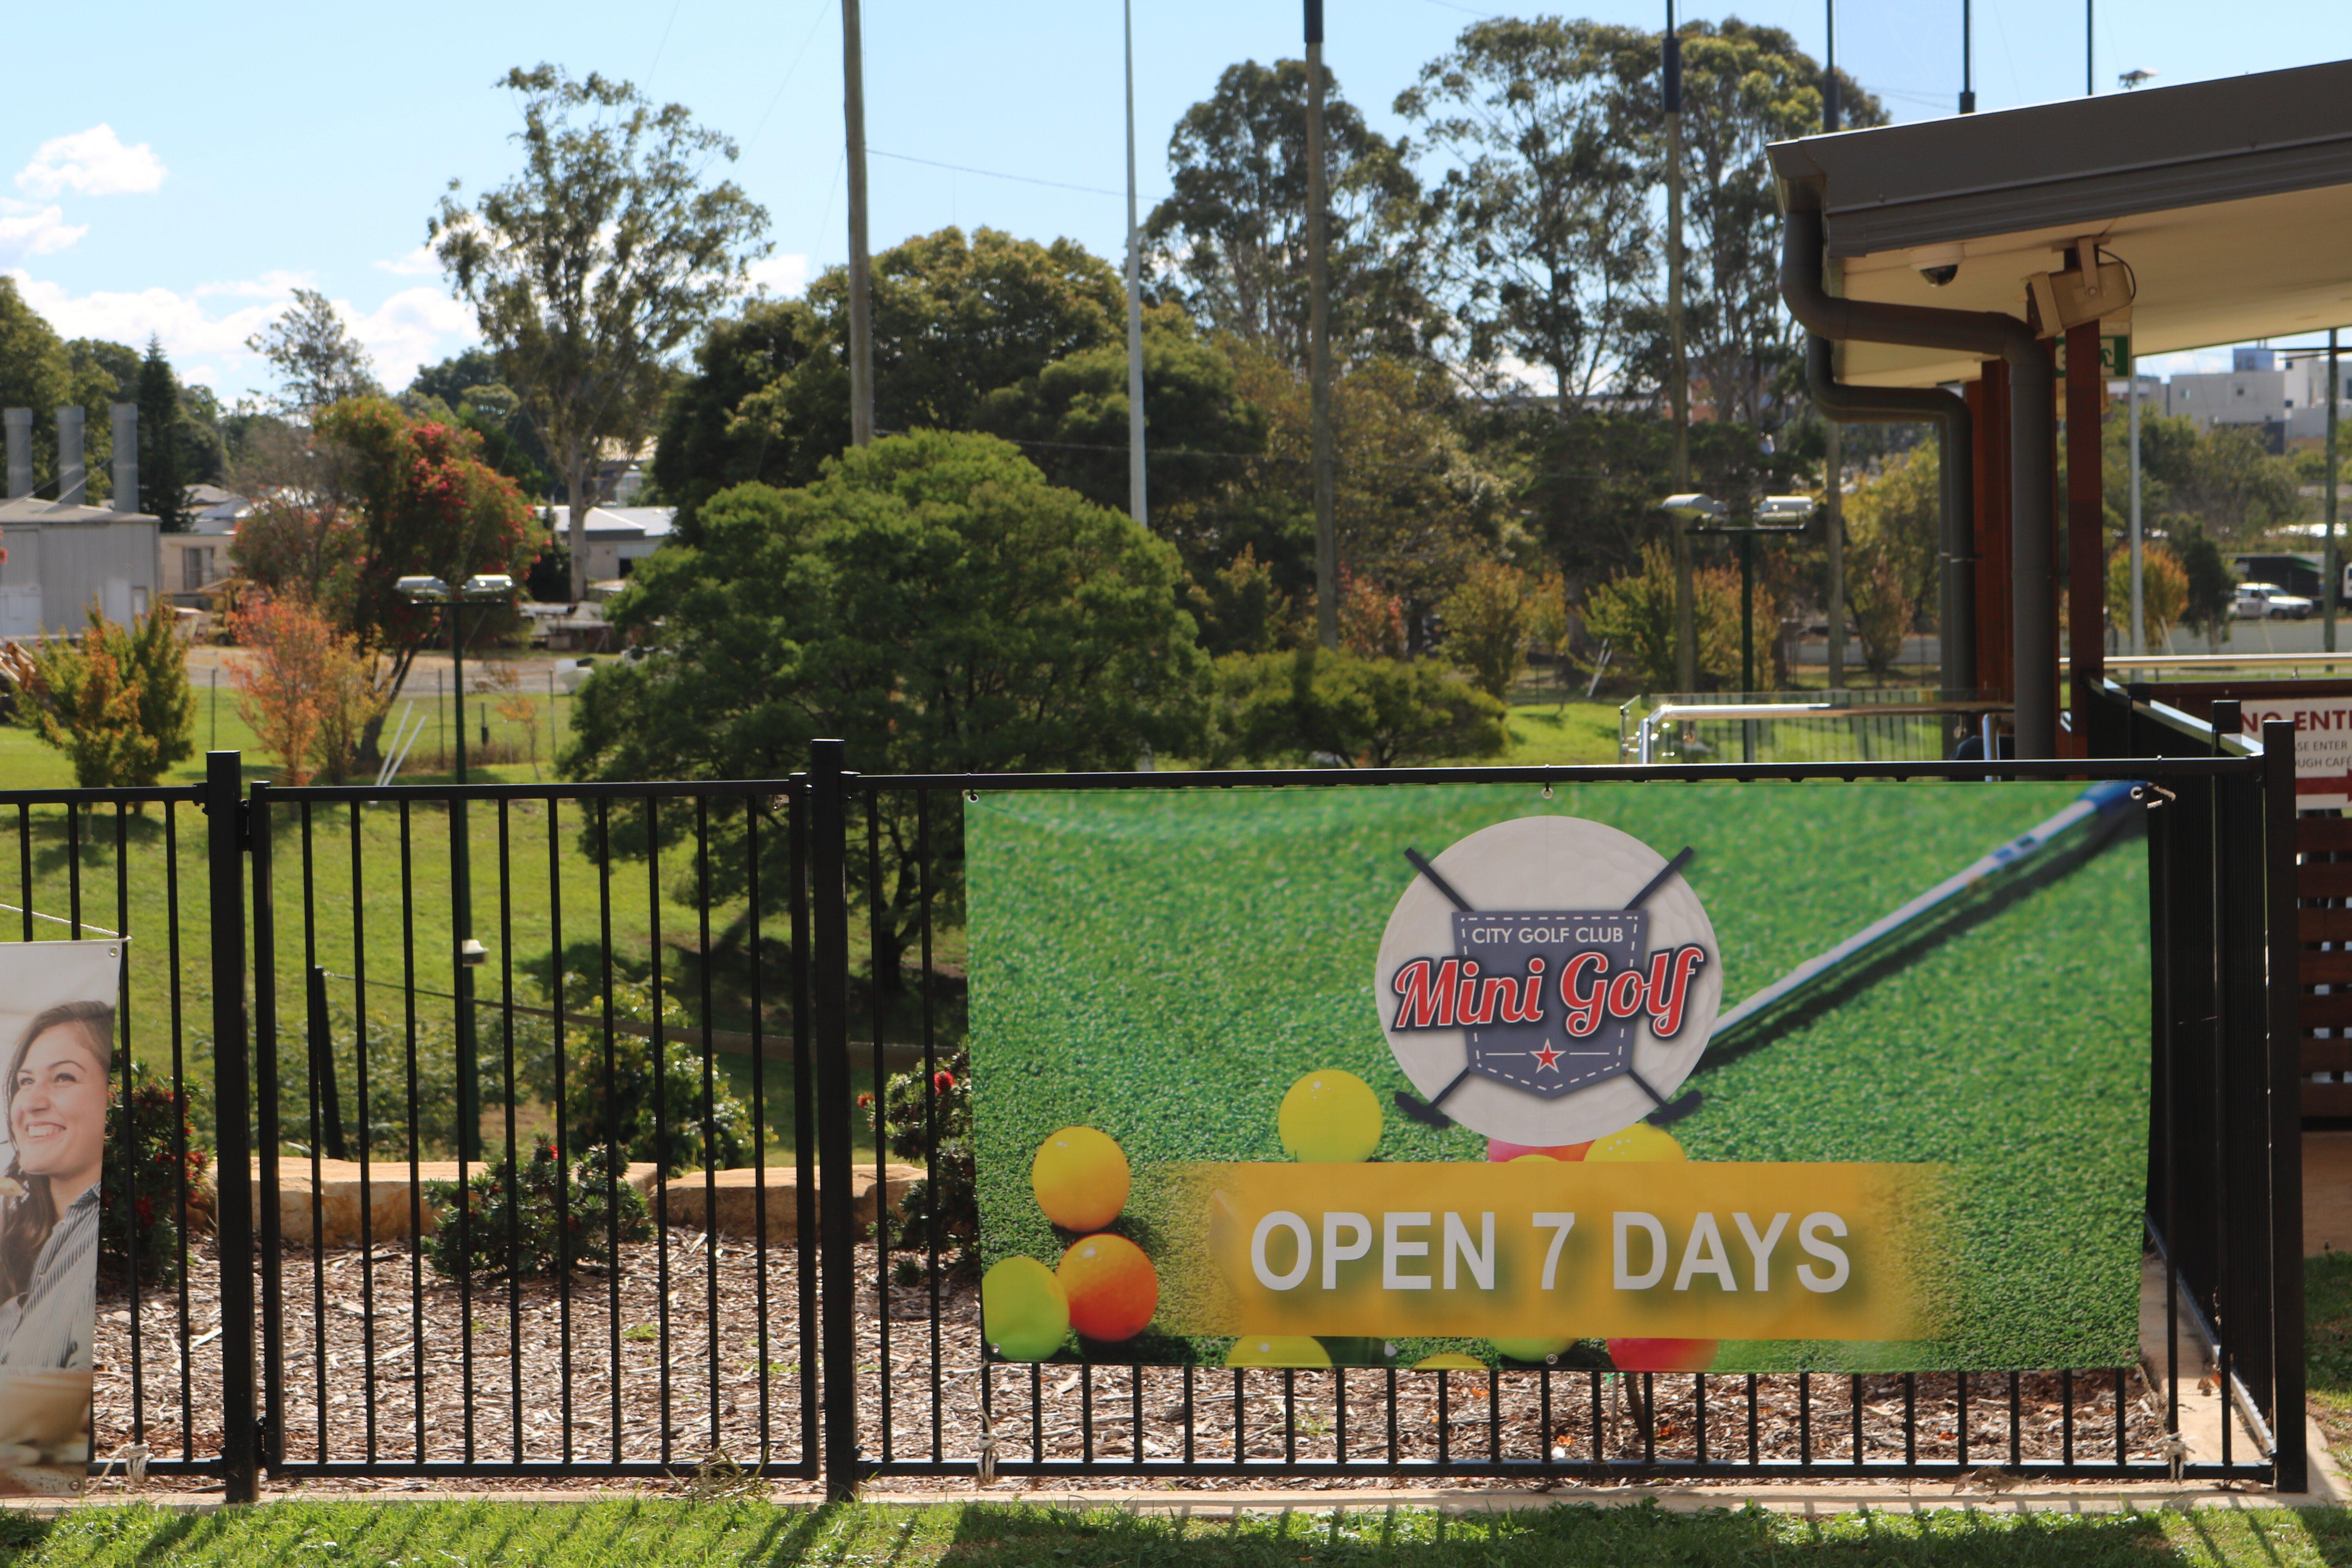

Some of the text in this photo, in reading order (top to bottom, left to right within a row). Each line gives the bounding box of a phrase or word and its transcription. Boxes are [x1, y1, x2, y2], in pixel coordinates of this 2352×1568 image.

[2294, 710, 2352, 731] ENT
[2314, 740, 2347, 750] ENTER
[1472, 927, 1623, 943] CITY GOLF CLUB
[1391, 944, 1707, 1041] Mini Golf
[1250, 1211, 1851, 1292] OPEN 7 DAYS
